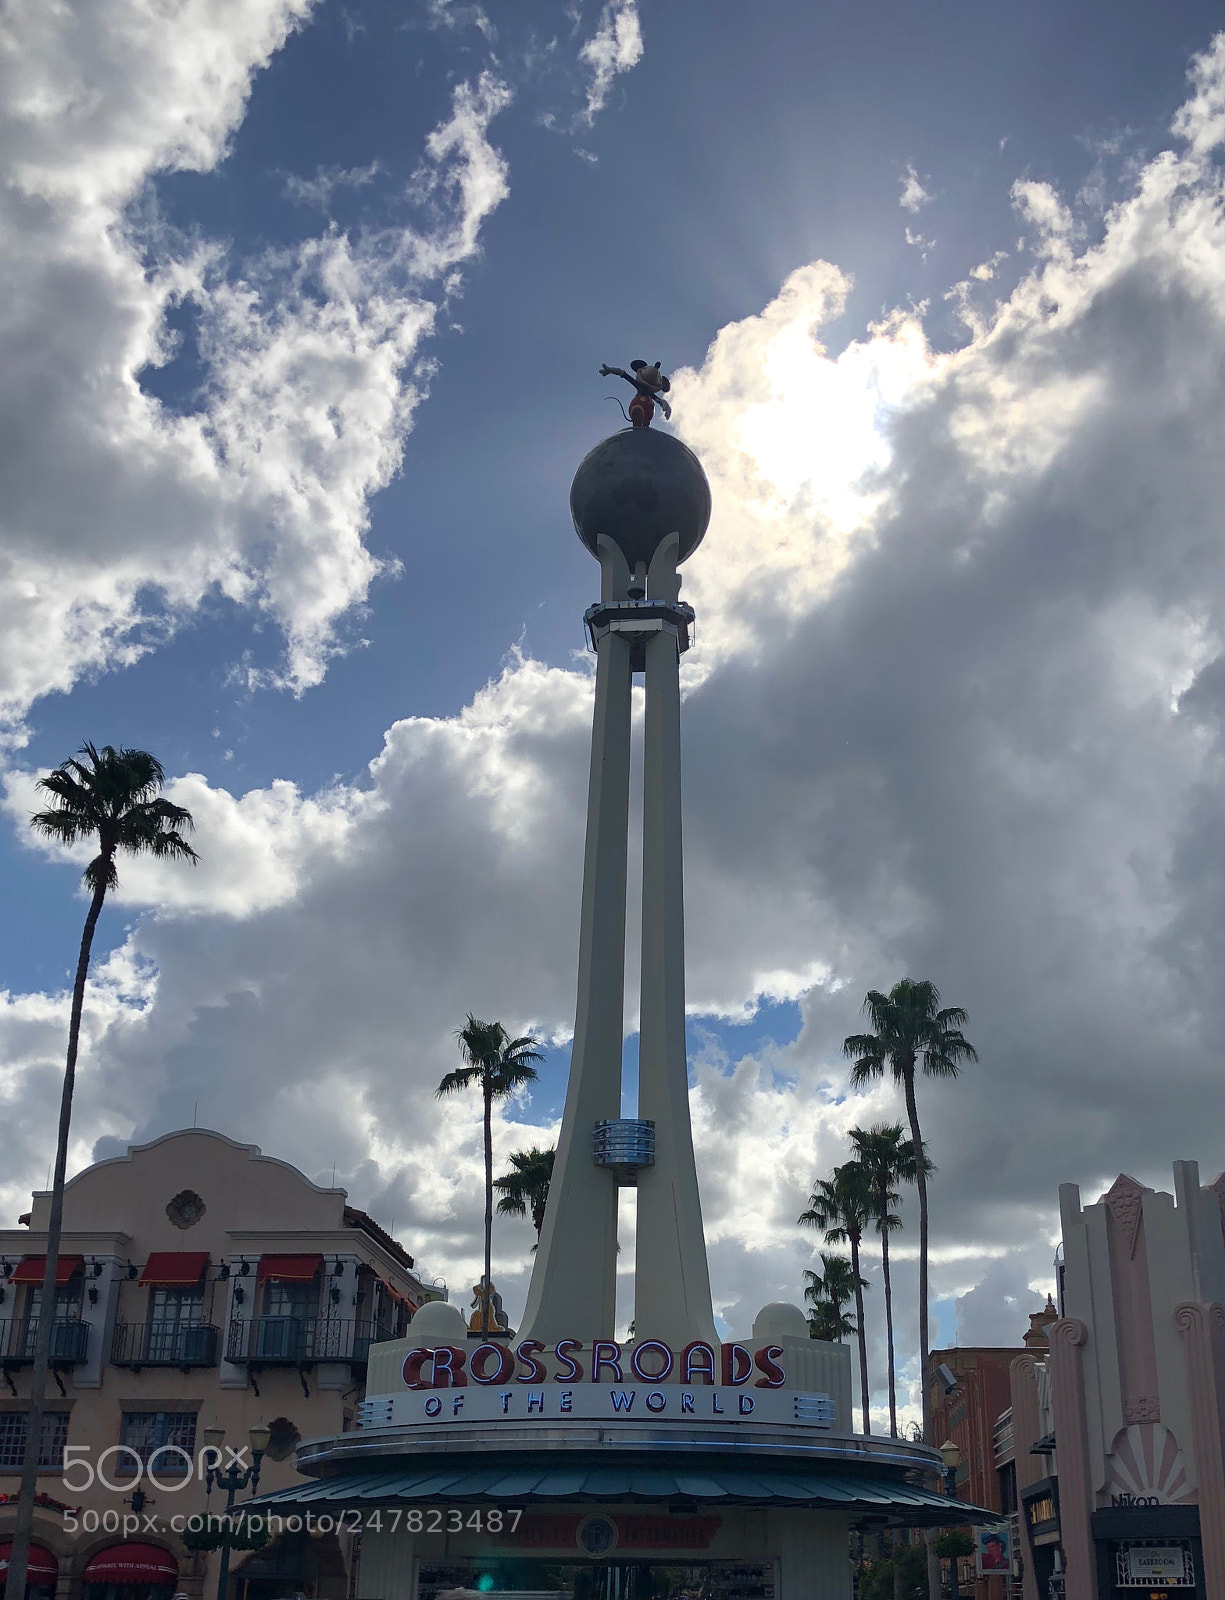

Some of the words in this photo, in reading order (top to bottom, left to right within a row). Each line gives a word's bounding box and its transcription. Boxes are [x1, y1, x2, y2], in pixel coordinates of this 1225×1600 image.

[401, 1338, 787, 1391] CROSSROADS
[424, 1395, 465, 1418] OF
[500, 1391, 574, 1414] THE
[610, 1391, 756, 1415] WORLD
[1111, 1492, 1160, 1509] Nikon
